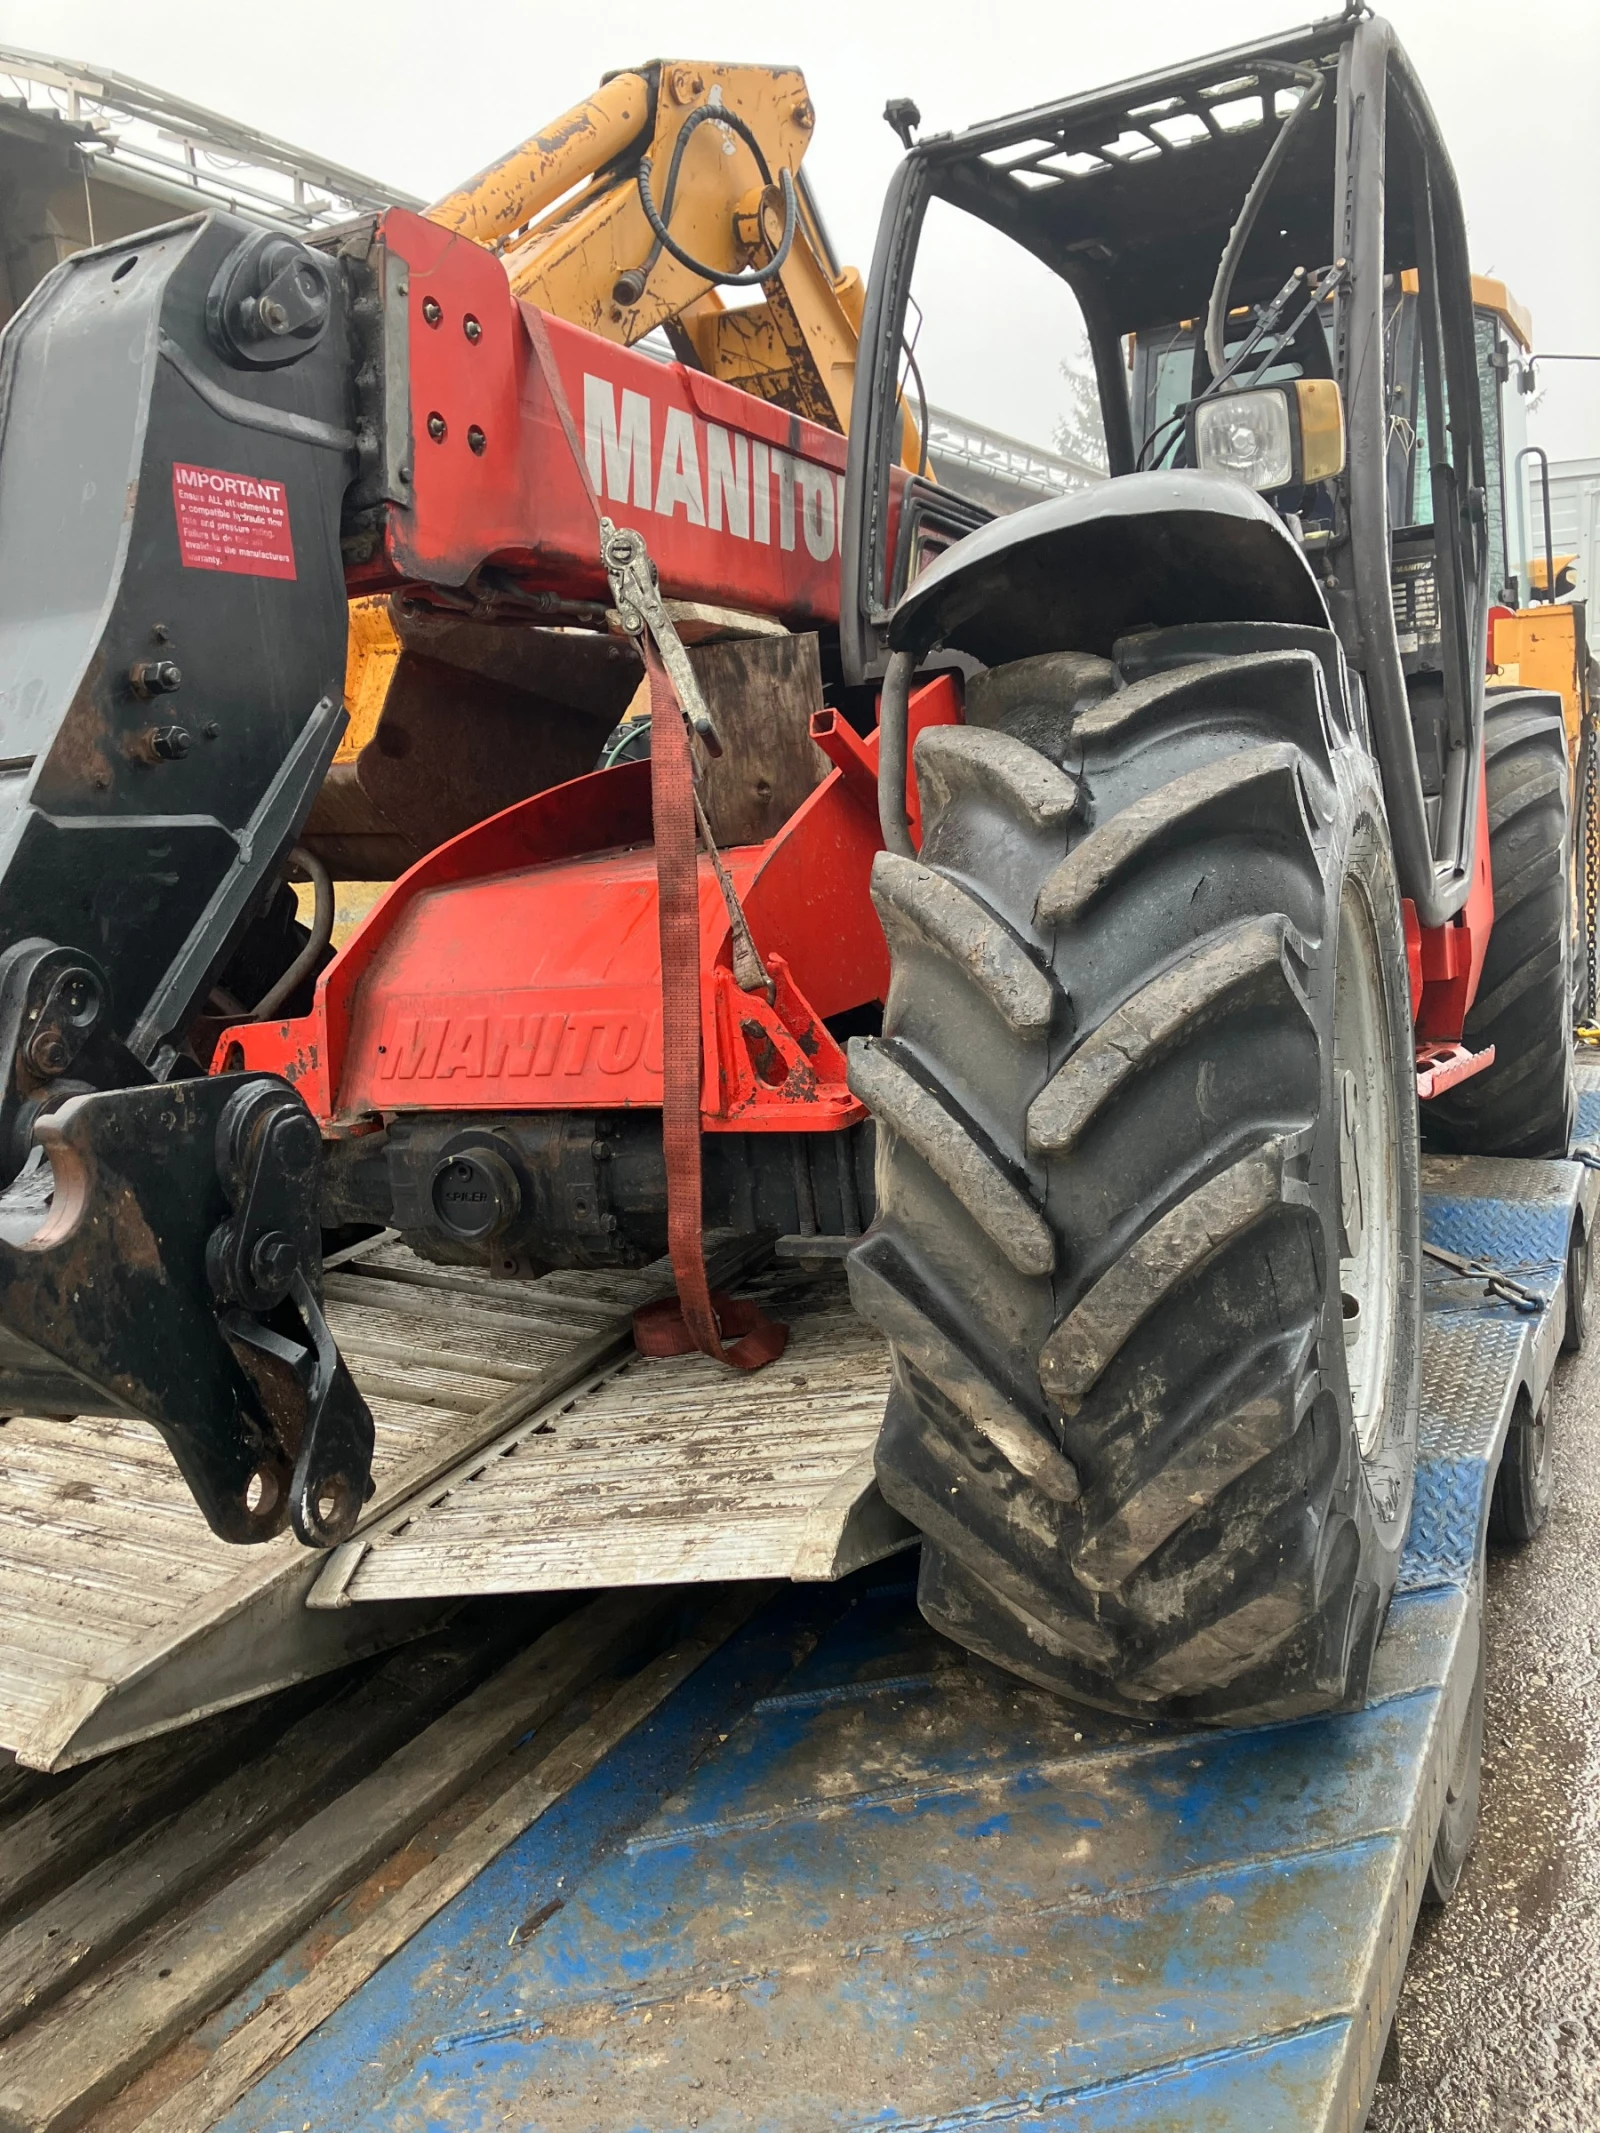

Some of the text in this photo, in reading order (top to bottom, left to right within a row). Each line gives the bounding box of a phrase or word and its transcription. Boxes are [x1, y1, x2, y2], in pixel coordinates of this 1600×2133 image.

[176, 468, 280, 501] IMPORTANT
[178, 489, 205, 502] Ensure
[208, 494, 222, 505] ALL
[273, 507, 285, 517] are
[188, 505, 231, 519] compatible
[233, 511, 266, 525] hydraulic
[267, 517, 283, 528] flow
[200, 519, 215, 528] and
[217, 523, 250, 534] pressure
[183, 527, 209, 540] Failure
[211, 531, 220, 541] to
[222, 533, 233, 542] do
[224, 545, 237, 555] the
[239, 548, 290, 563] manufacturers
